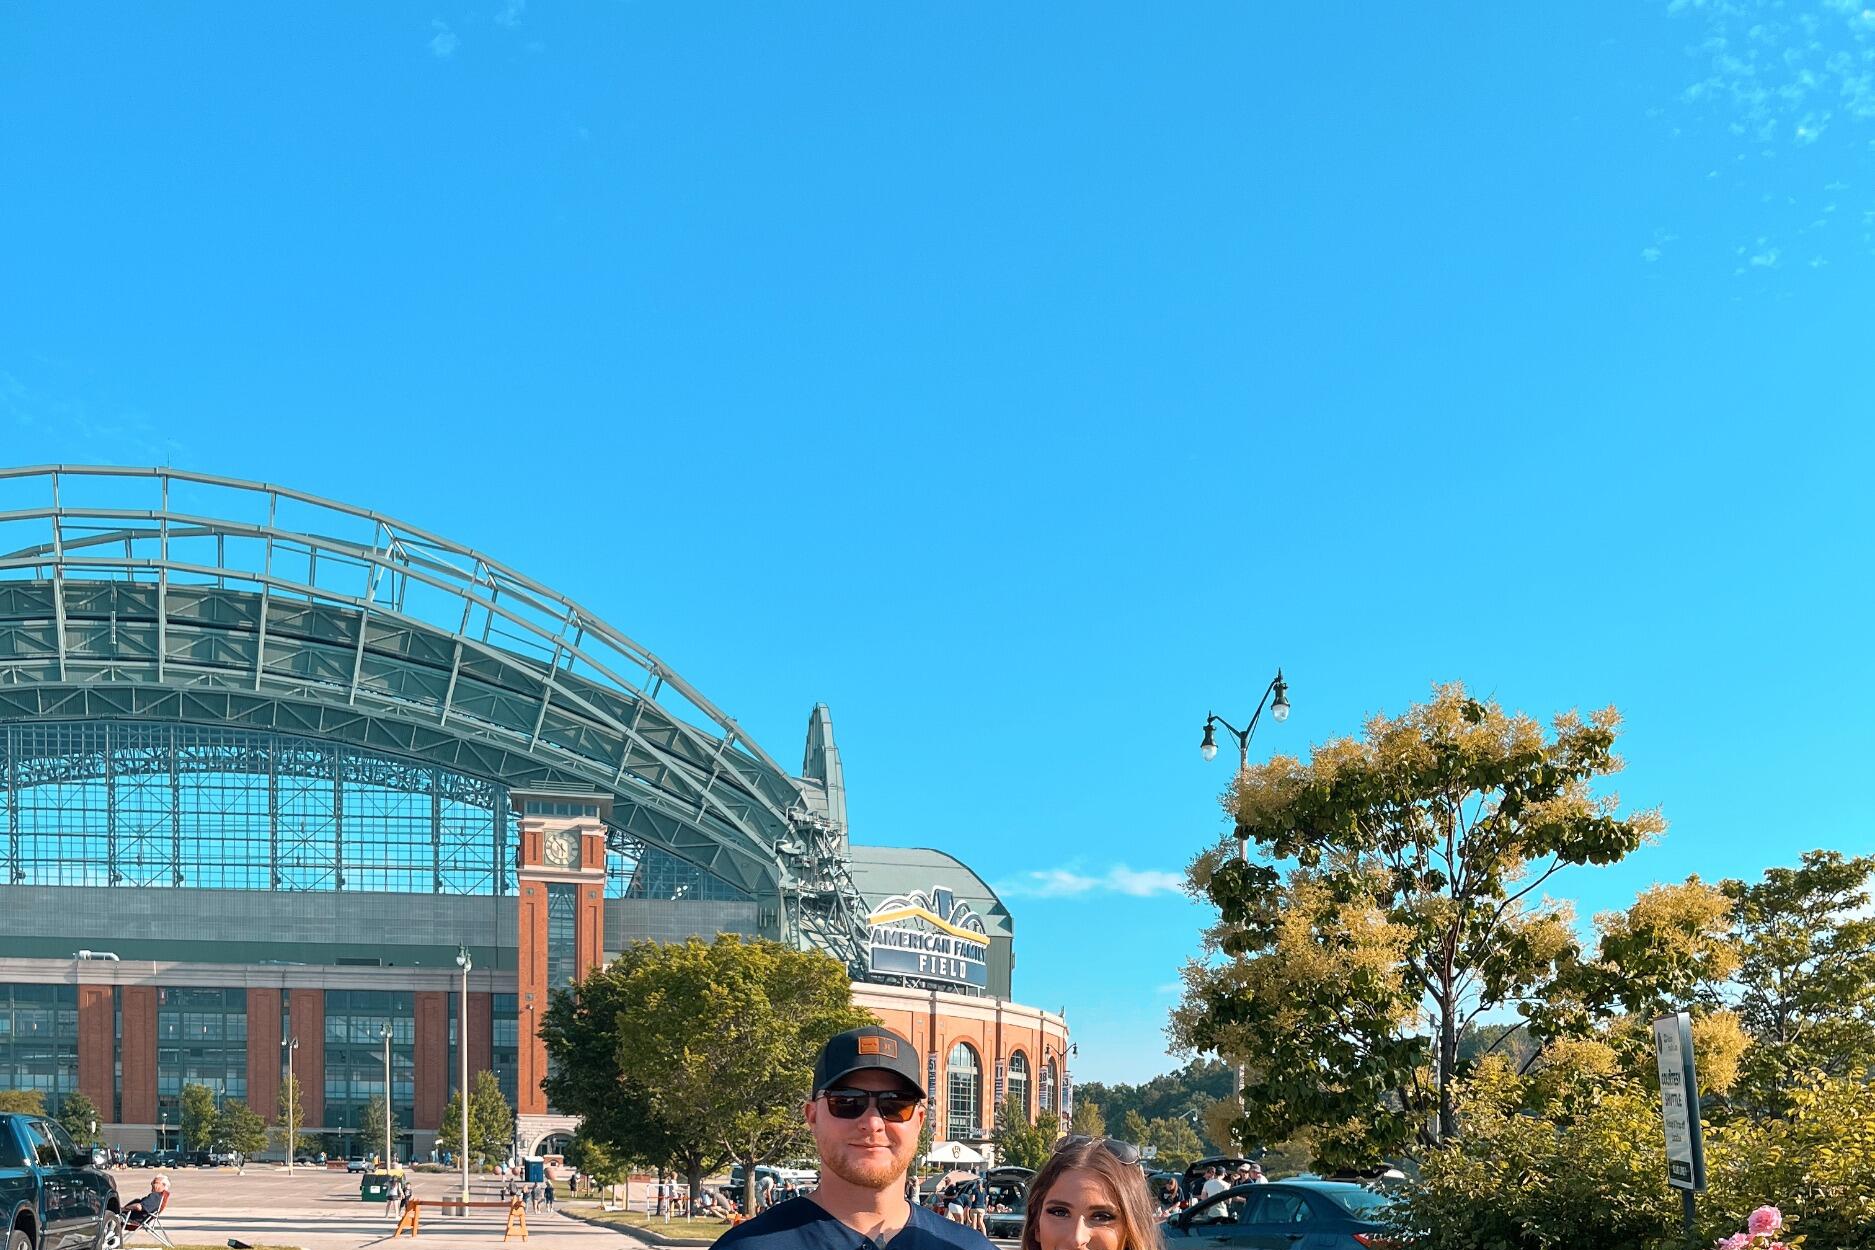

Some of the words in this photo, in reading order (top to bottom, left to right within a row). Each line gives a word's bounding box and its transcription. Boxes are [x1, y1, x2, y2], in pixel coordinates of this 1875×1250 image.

[871, 927, 951, 955] AMERICAN
[954, 939, 985, 962] FAMILY
[919, 954, 966, 979] FIELD
